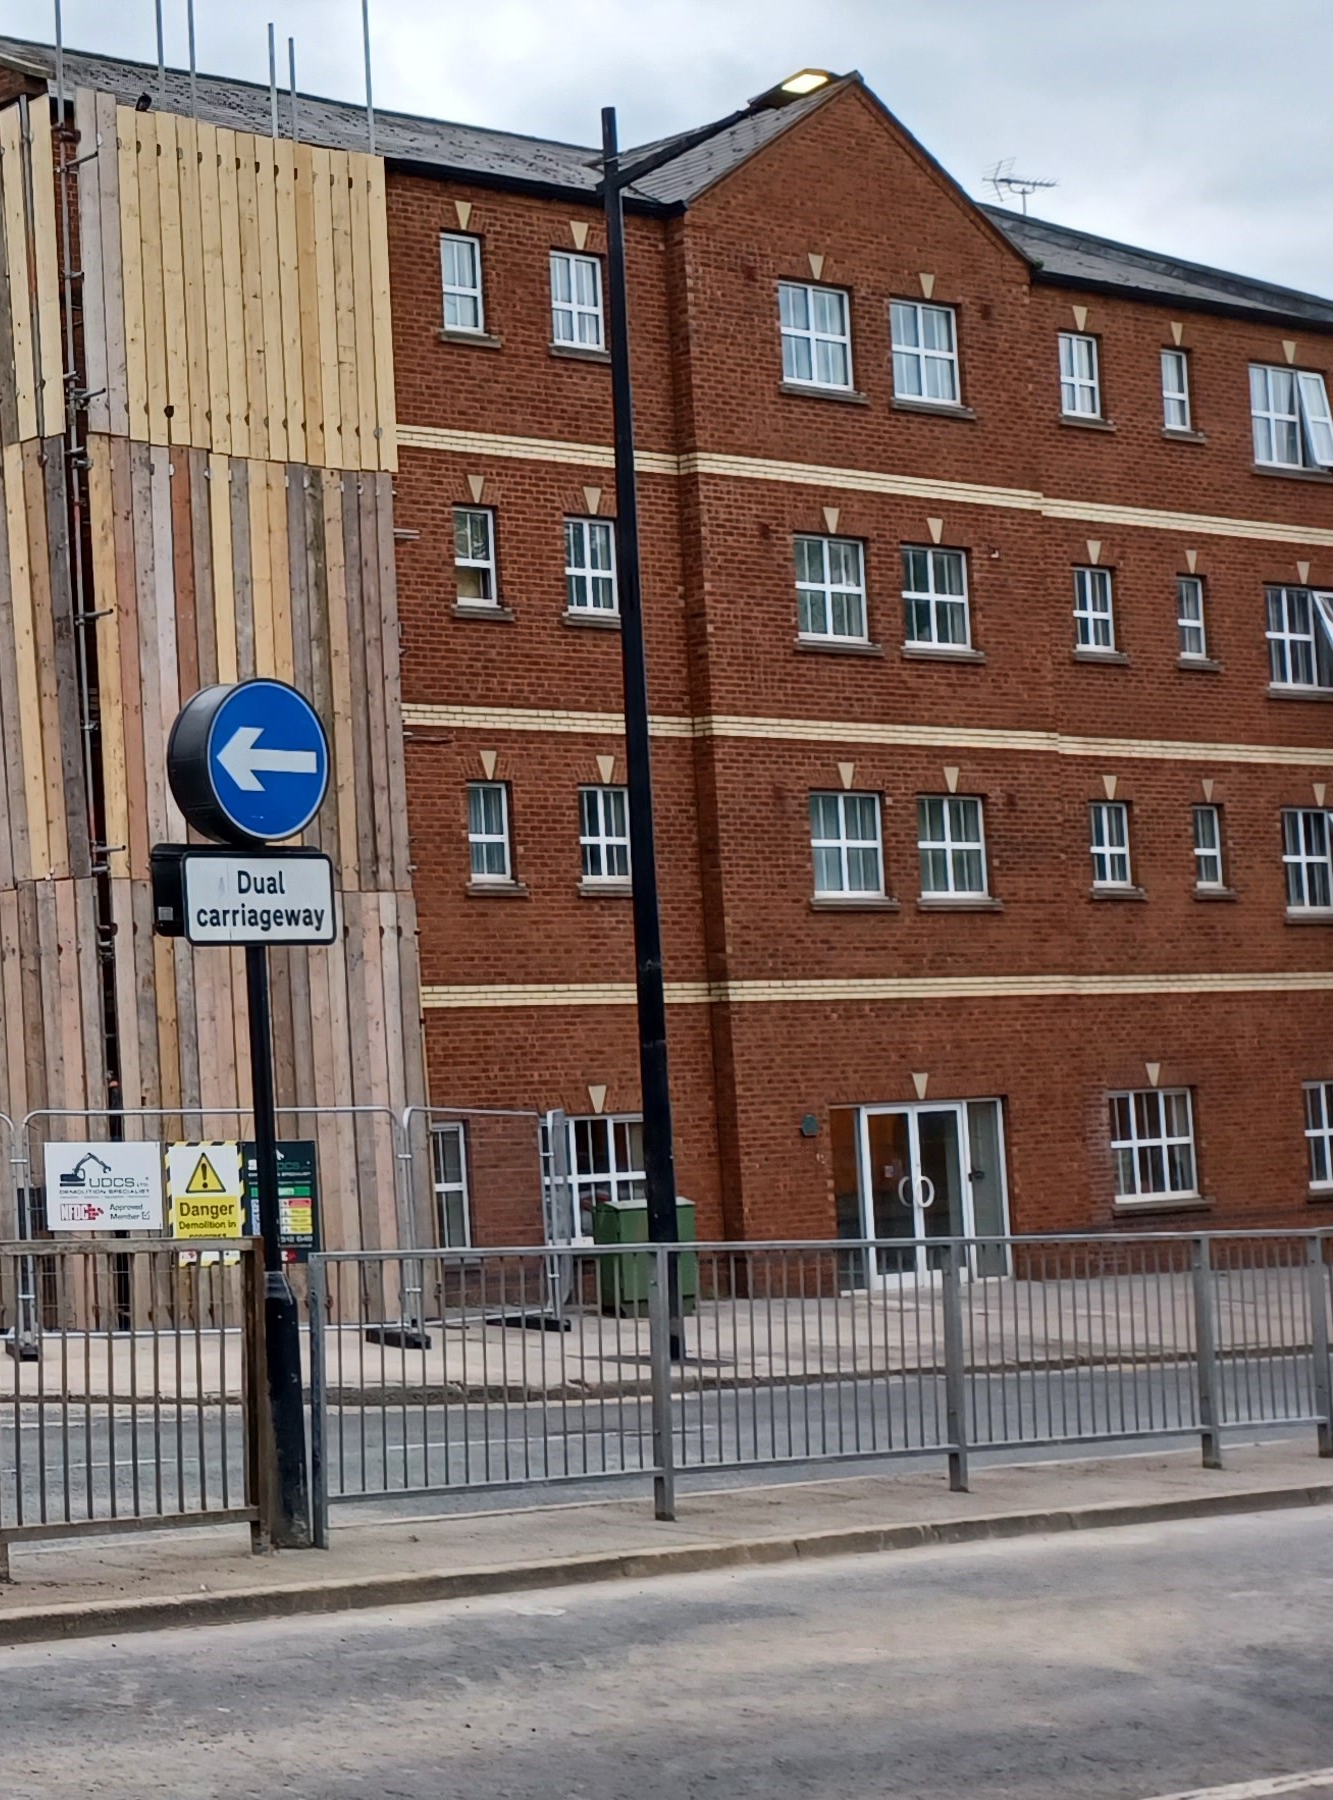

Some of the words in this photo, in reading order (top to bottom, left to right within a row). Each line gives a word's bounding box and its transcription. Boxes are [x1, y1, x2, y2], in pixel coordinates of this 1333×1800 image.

[237, 870, 285, 895] Dual
[196, 903, 325, 932] carriageway
[89, 1177, 135, 1188] UDCS
[60, 1204, 90, 1220] NFDC
[109, 1203, 143, 1212] Approved
[179, 1202, 234, 1219] Danger
[178, 1220, 226, 1230] Demolition
[227, 1219, 237, 1228] in
